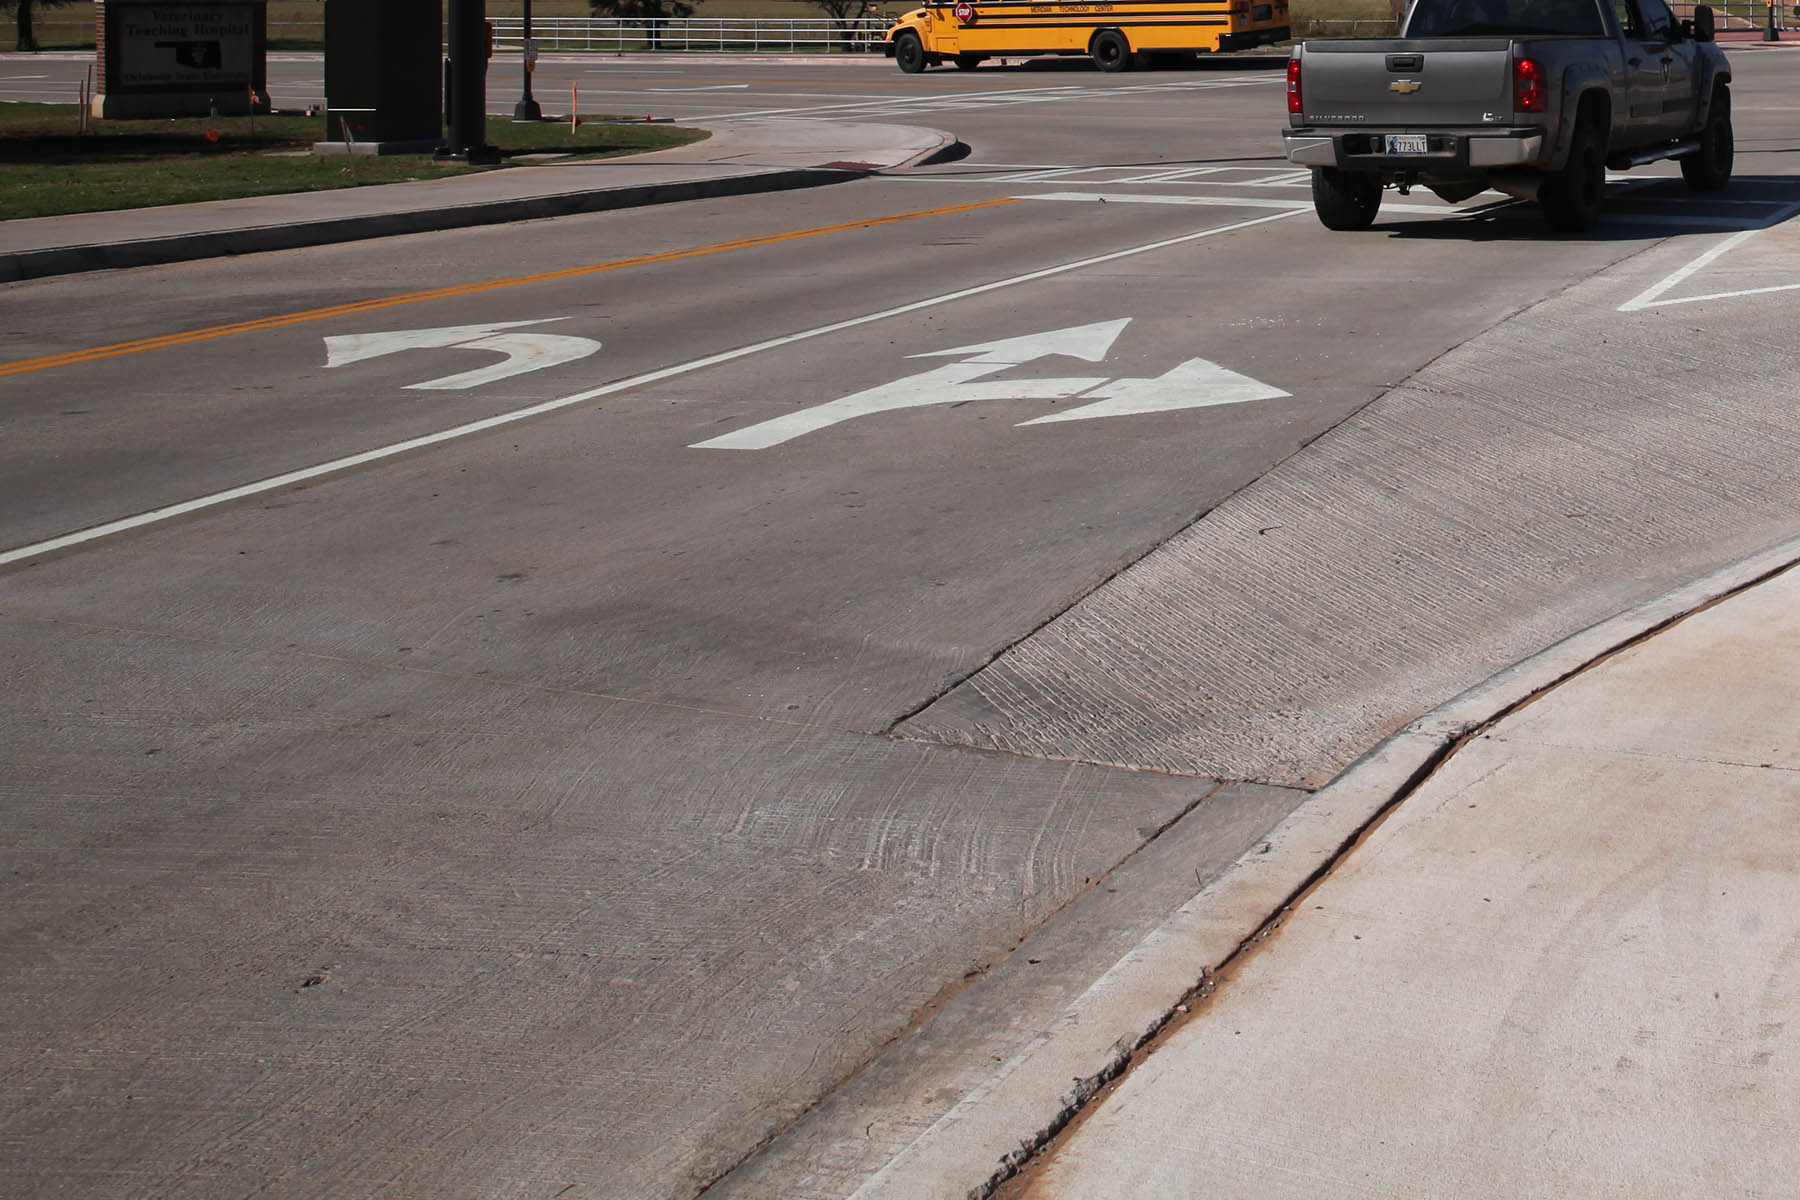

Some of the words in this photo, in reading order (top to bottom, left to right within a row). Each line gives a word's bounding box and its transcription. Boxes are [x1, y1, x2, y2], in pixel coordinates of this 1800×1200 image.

[958, 8, 970, 17] STOP
[1059, 5, 1090, 13] TECHNOLOGY
[1094, 4, 1113, 12] CENTER
[152, 10, 224, 22] Veterinary
[127, 24, 189, 38] Teaching
[195, 24, 249, 37] Hospital
